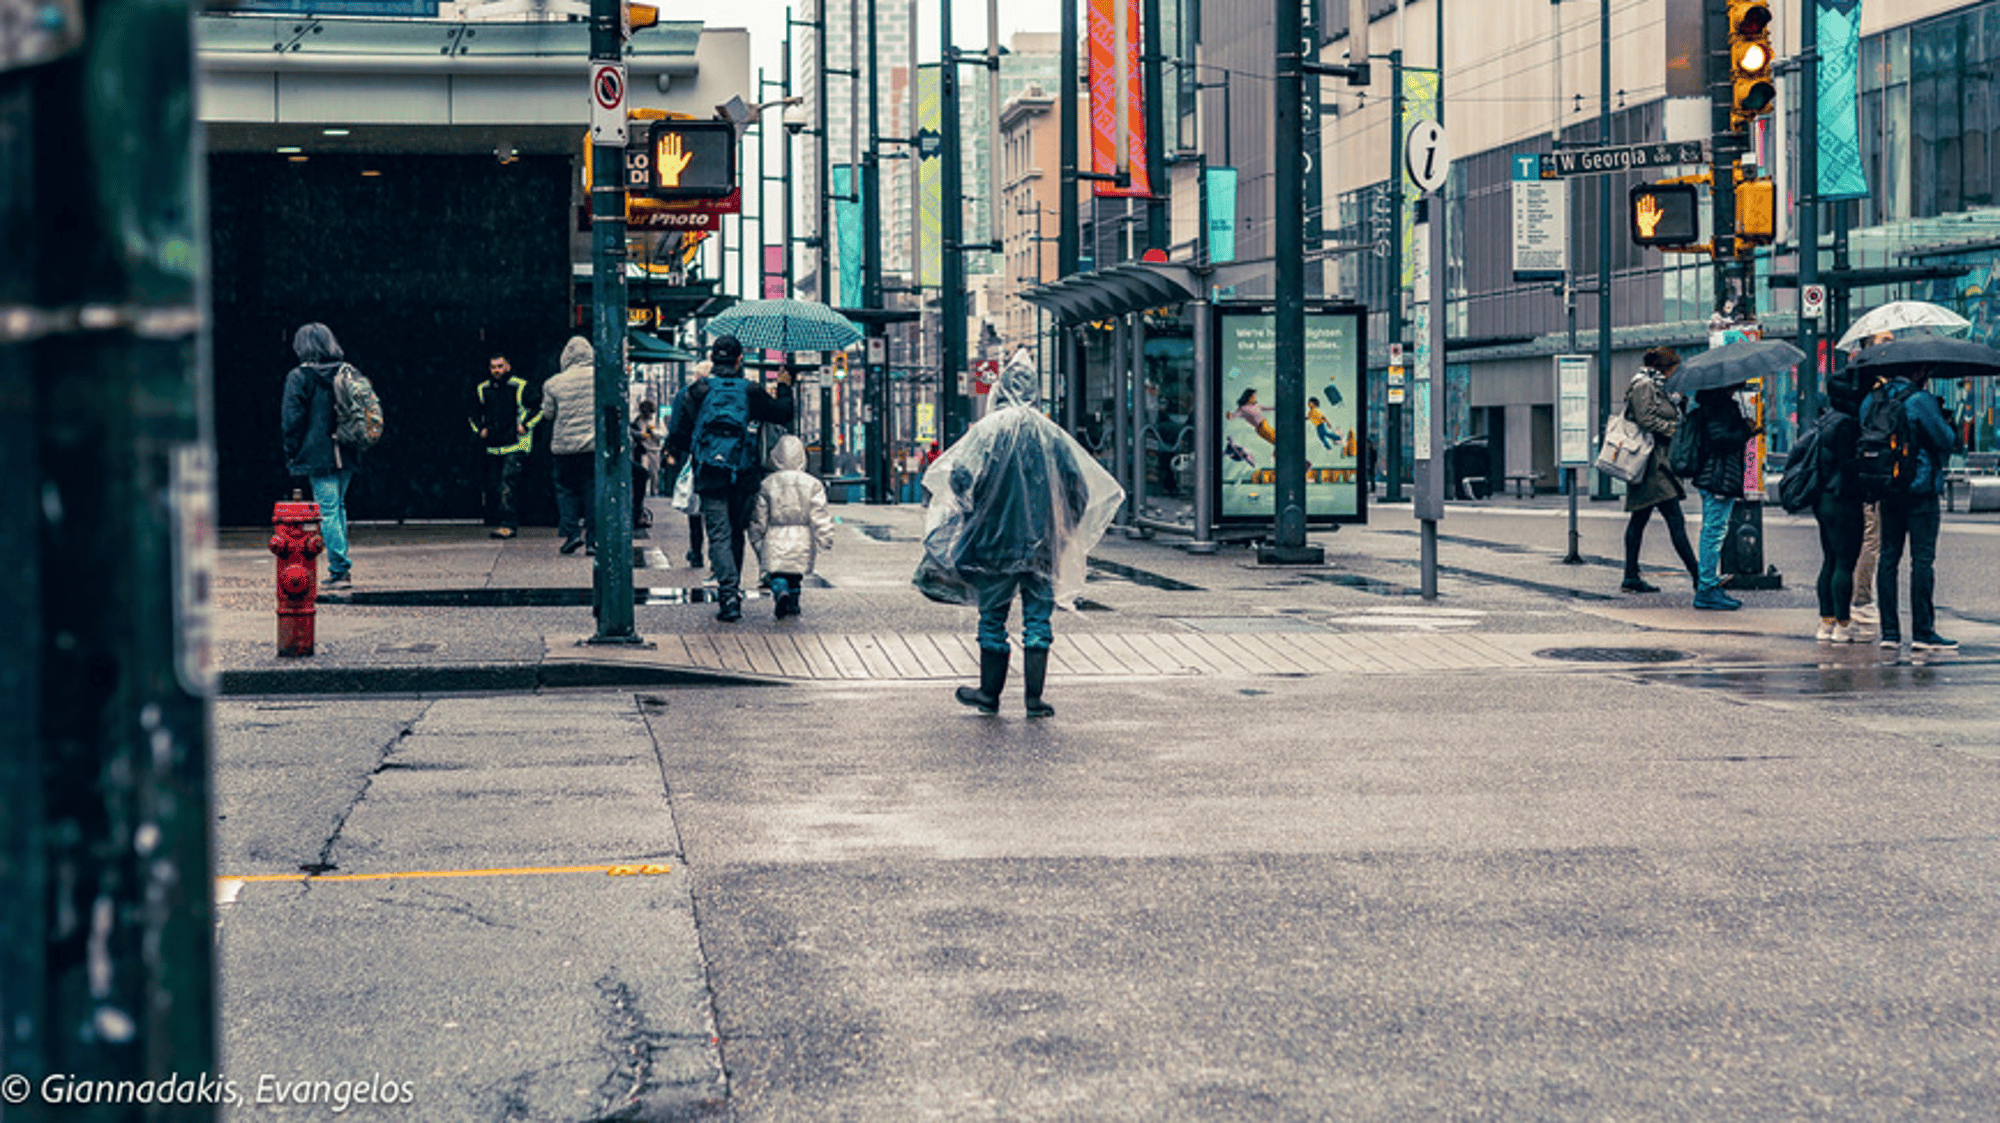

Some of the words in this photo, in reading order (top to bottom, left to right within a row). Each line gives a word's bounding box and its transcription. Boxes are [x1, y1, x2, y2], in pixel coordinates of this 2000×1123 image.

[1518, 157, 1533, 177] T
[1561, 154, 1576, 171] W
[1581, 149, 1646, 171] Georgia
[650, 213, 709, 226] Photo
